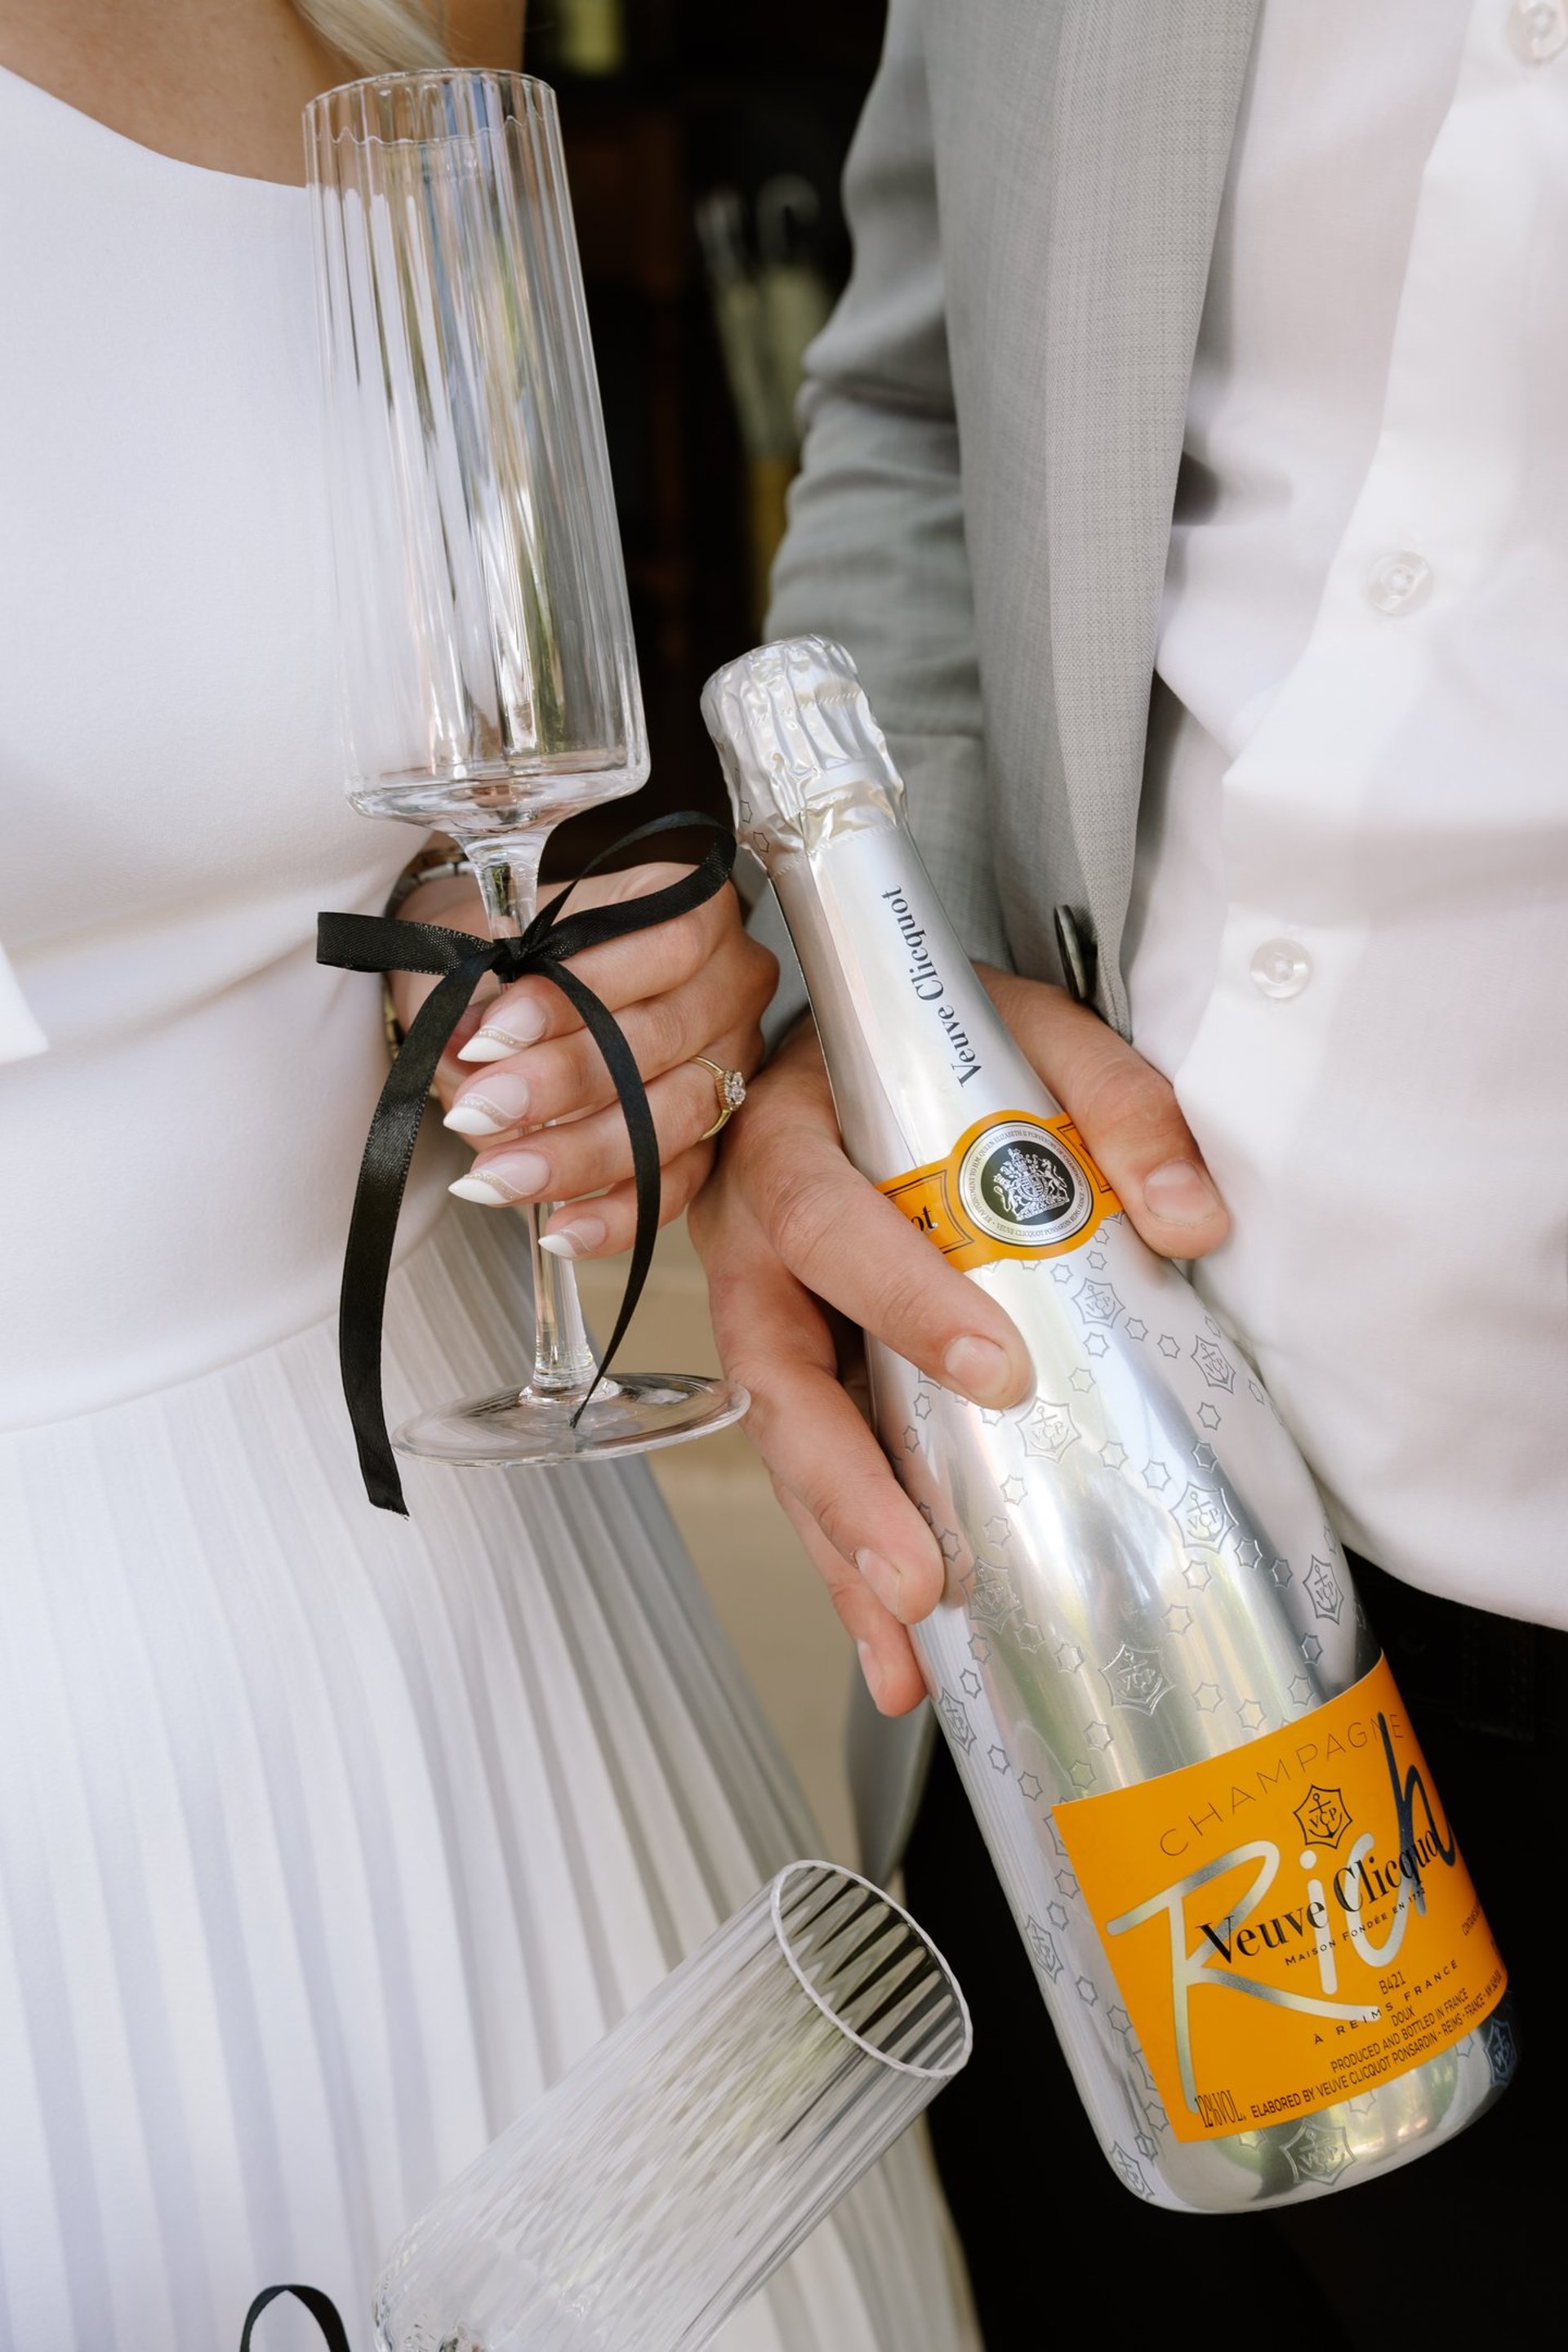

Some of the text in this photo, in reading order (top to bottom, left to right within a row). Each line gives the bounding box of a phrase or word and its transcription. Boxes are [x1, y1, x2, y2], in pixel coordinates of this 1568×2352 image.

[882, 886, 982, 1088] Veuve Clicquot
[1160, 1713, 1404, 1856] CHAMPAGNE
[1106, 1711, 1456, 2114] Rich
[1195, 1900, 1330, 1965] Veuve
[1284, 1940, 1337, 1967] MAISON
[1342, 1912, 1388, 1941] FONDÉE
[1392, 1901, 1405, 1914] EN
[1314, 2033, 1324, 2045] À
[1336, 2002, 1394, 2036] REIMS
[1403, 1959, 1459, 2002] FRANCE
[1379, 1971, 1406, 1995] B421
[1391, 2005, 1417, 2027] DOUX
[1250, 2093, 1302, 2118] ELABORED
[1303, 2087, 1316, 2104] BY
[1316, 2074, 1350, 2098] VEUVE
[1349, 2055, 1391, 2086] CLICQUOT
[1393, 2033, 1438, 2065] PONSARDIN
[1441, 2012, 1463, 2037] REIMS
[1464, 1992, 1486, 2019] FRANCE
[1330, 1988, 1469, 2074] PRODUCED AND BOTTLED IN FRANCE
